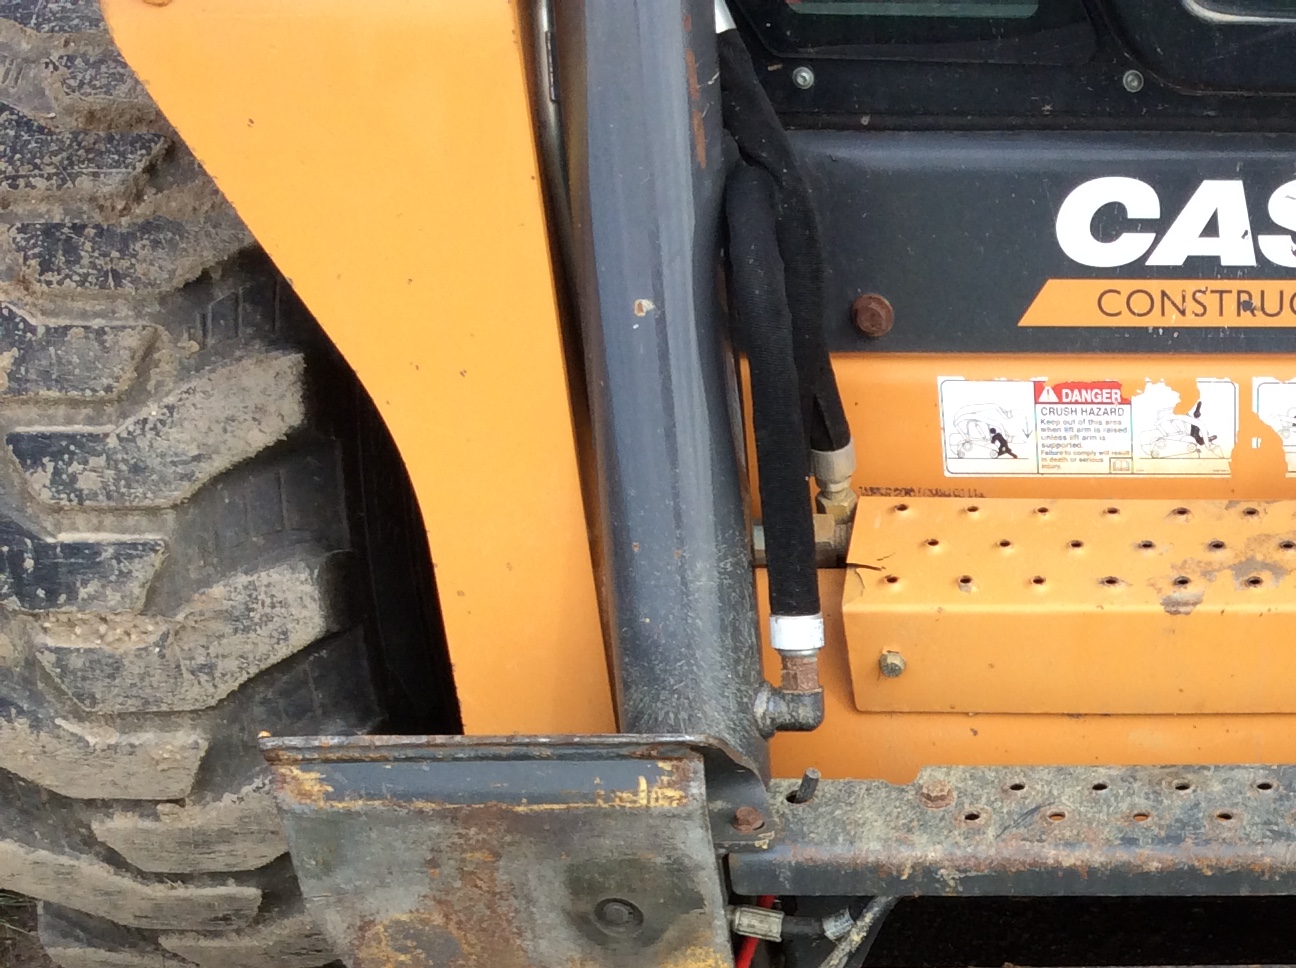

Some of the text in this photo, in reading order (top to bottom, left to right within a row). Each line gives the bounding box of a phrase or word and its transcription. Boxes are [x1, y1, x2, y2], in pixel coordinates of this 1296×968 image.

[1062, 389, 1121, 402] DANGER
[1041, 407, 1125, 416] CRUSH HAZARD
